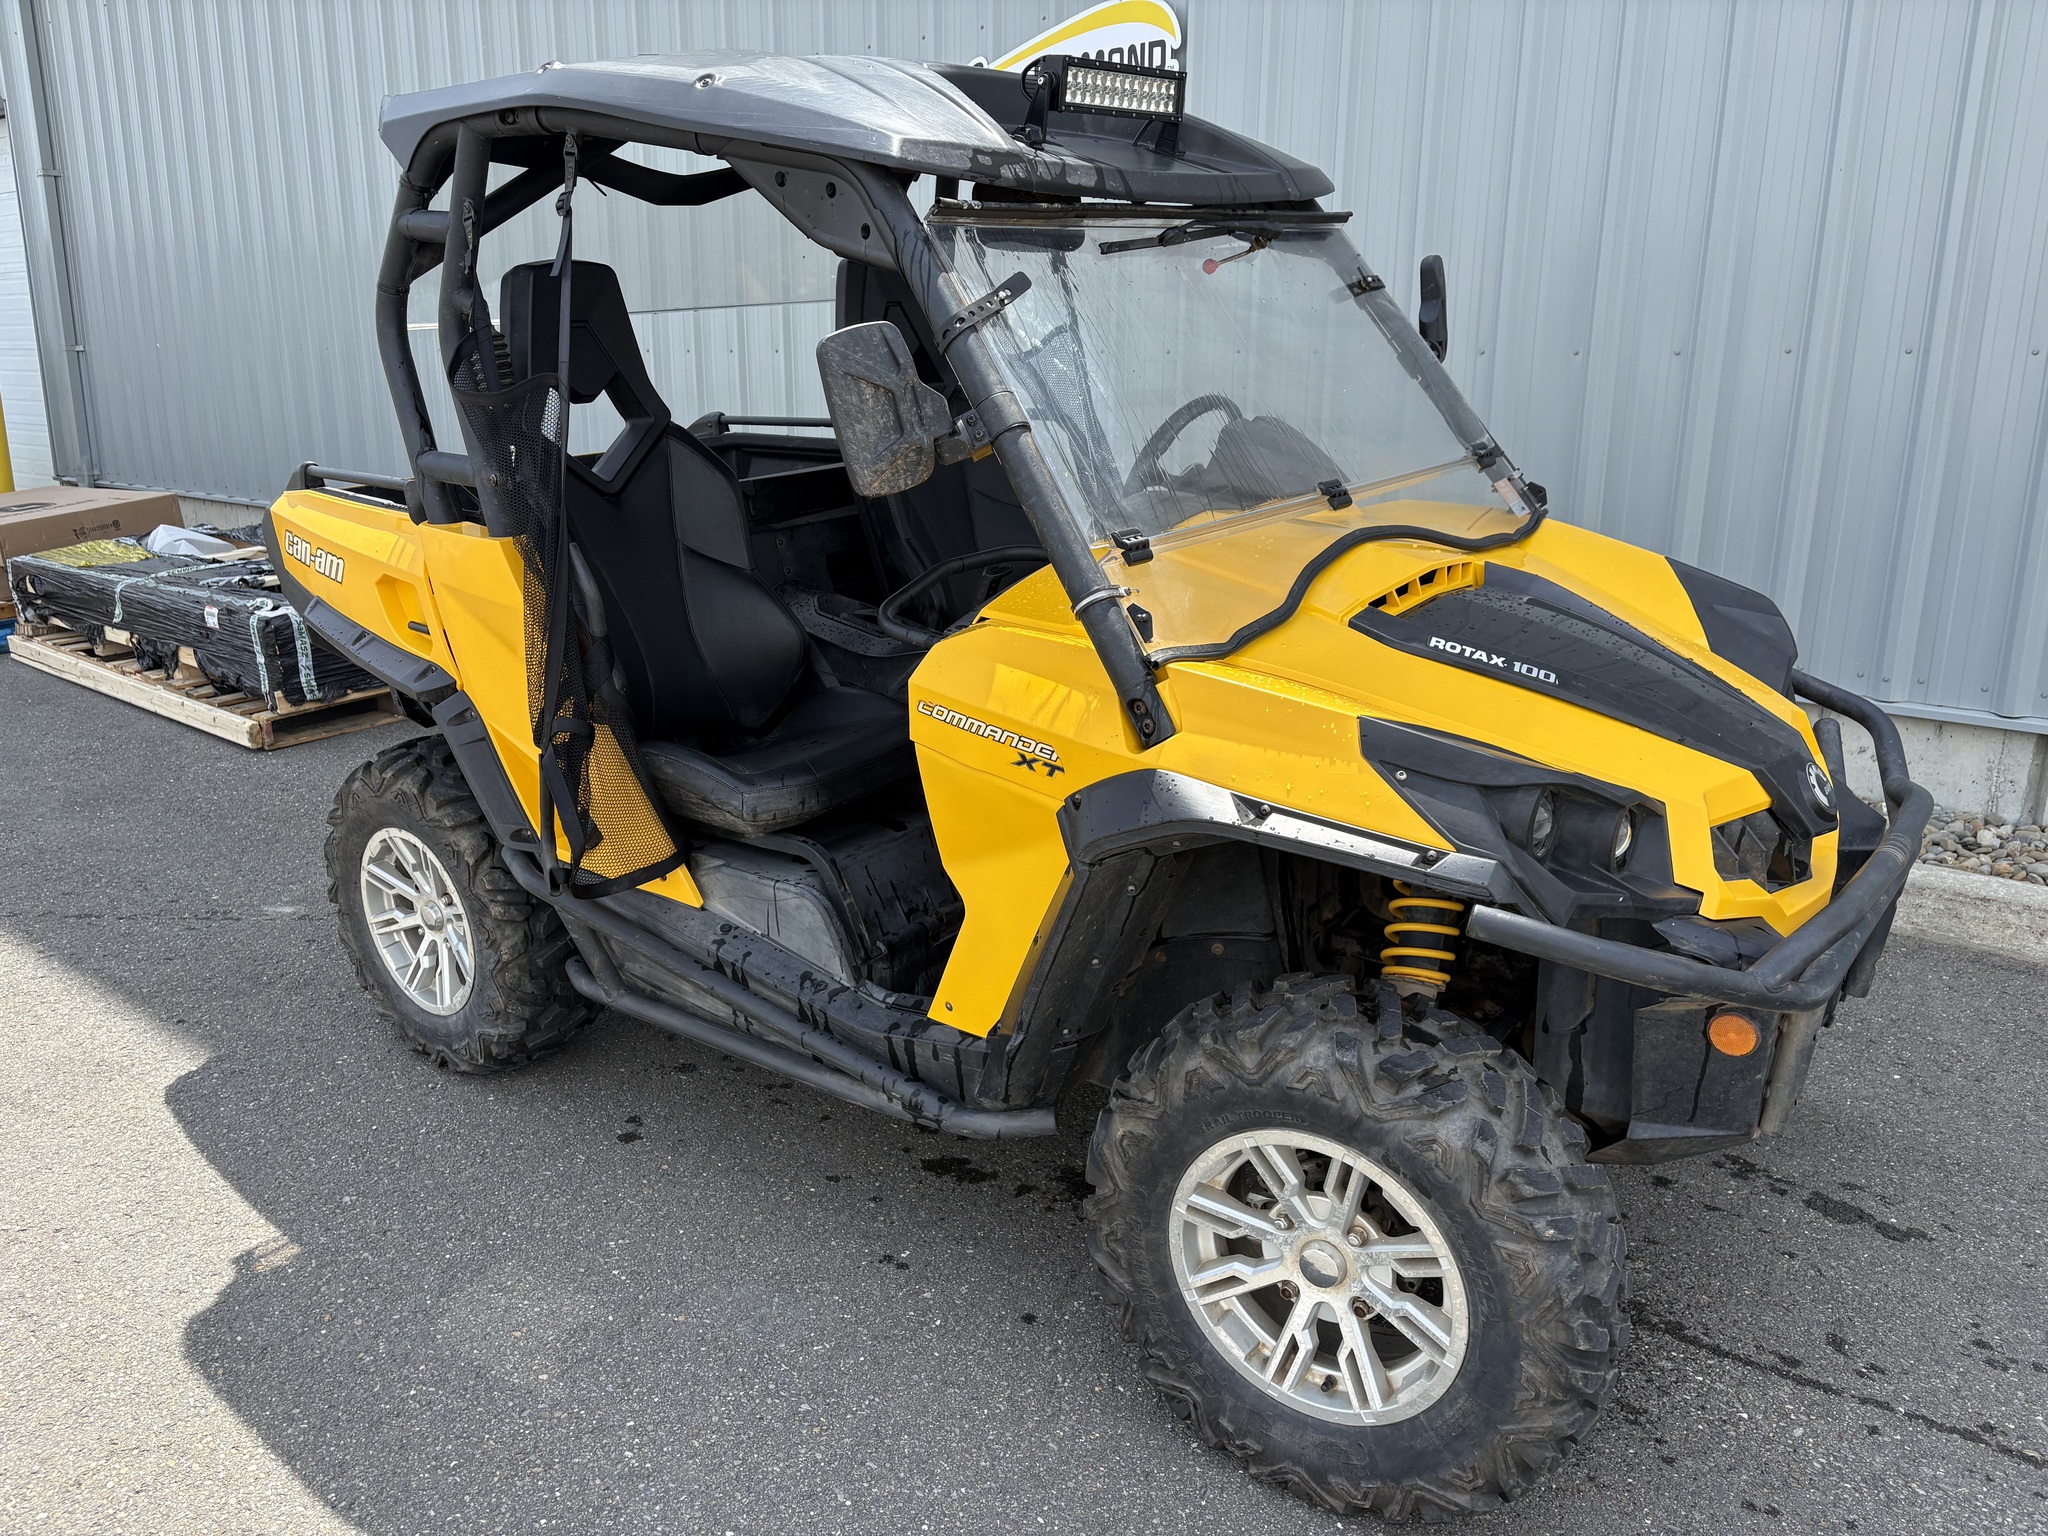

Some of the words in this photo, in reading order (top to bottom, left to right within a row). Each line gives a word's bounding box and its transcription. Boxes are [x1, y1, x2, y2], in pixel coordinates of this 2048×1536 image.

[285, 529, 345, 584] can-am
[1429, 636, 1508, 667] ROTAX
[1513, 661, 1559, 685] 100
[1010, 751, 1066, 779] XT
[1200, 1112, 1235, 1134] TRAIL
